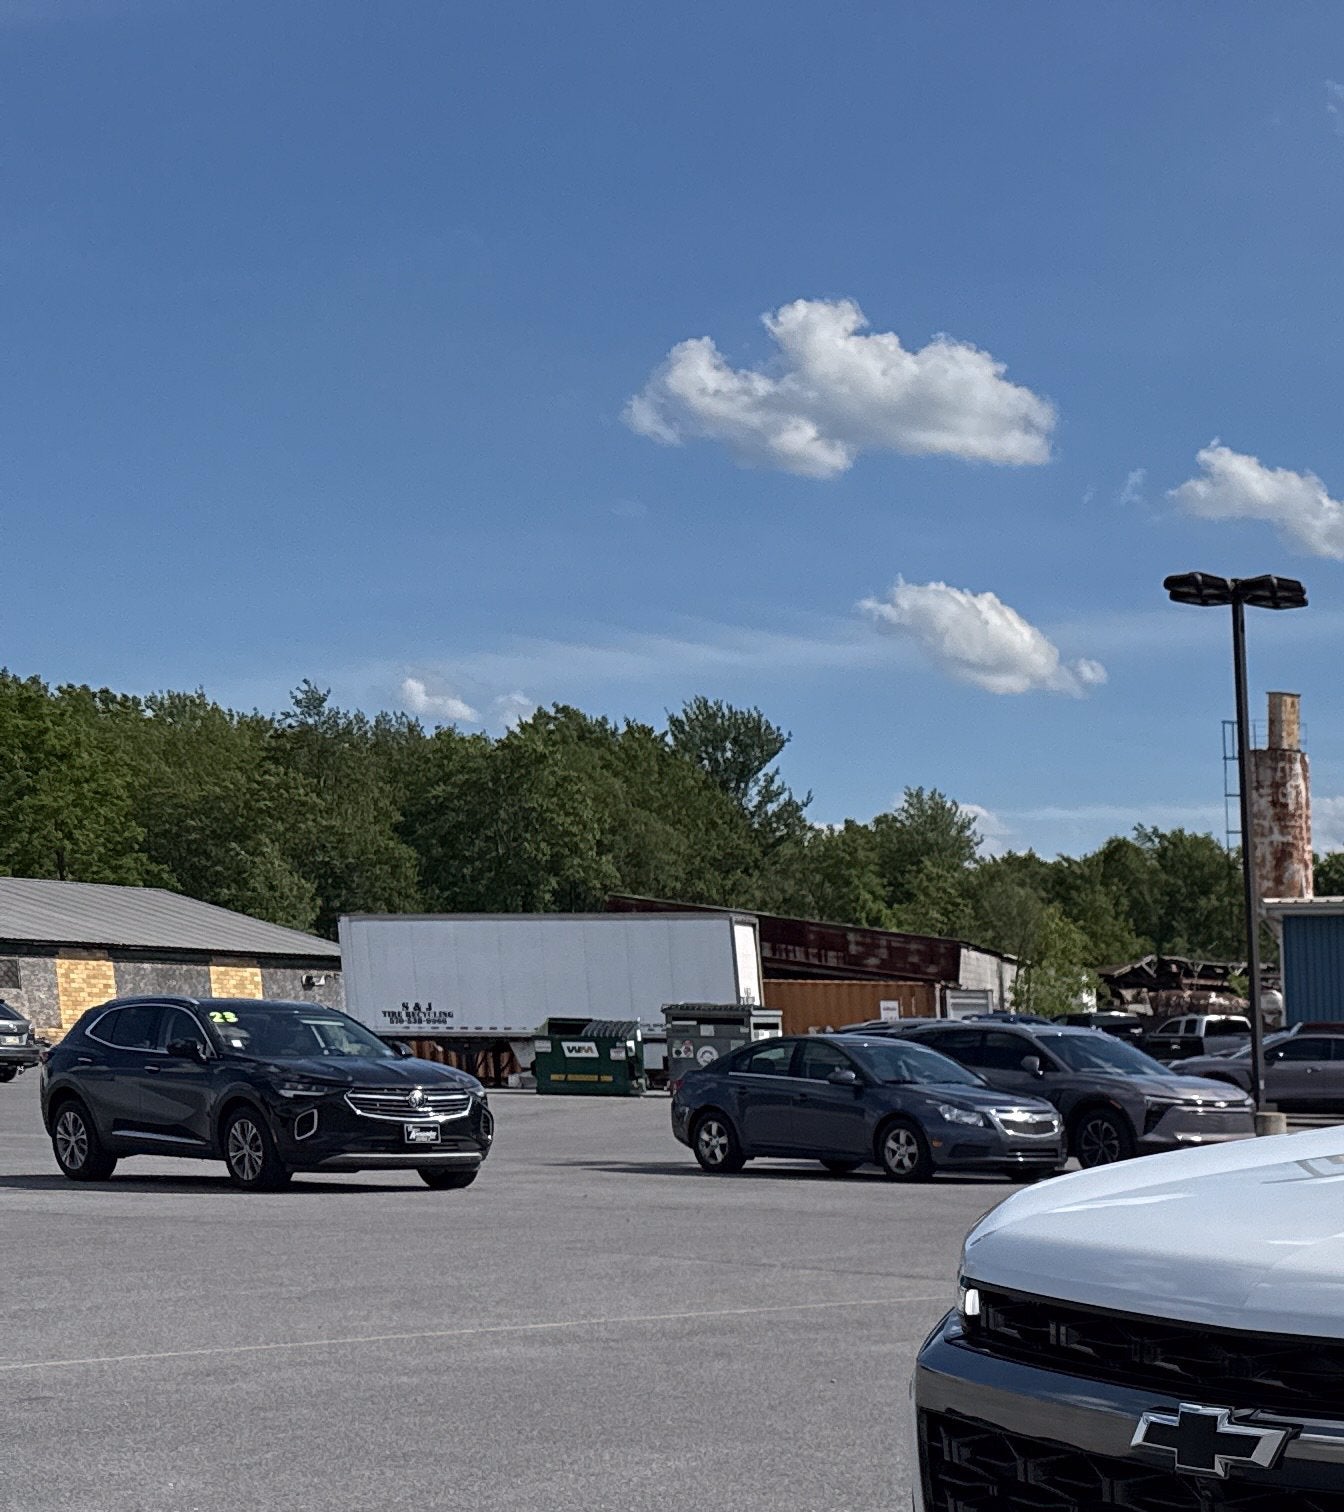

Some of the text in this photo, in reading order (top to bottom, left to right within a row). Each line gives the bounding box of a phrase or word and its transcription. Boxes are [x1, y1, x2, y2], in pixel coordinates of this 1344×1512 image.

[209, 1011, 239, 1023] 23
[382, 1010, 454, 1018] TIRE RECYCLING
